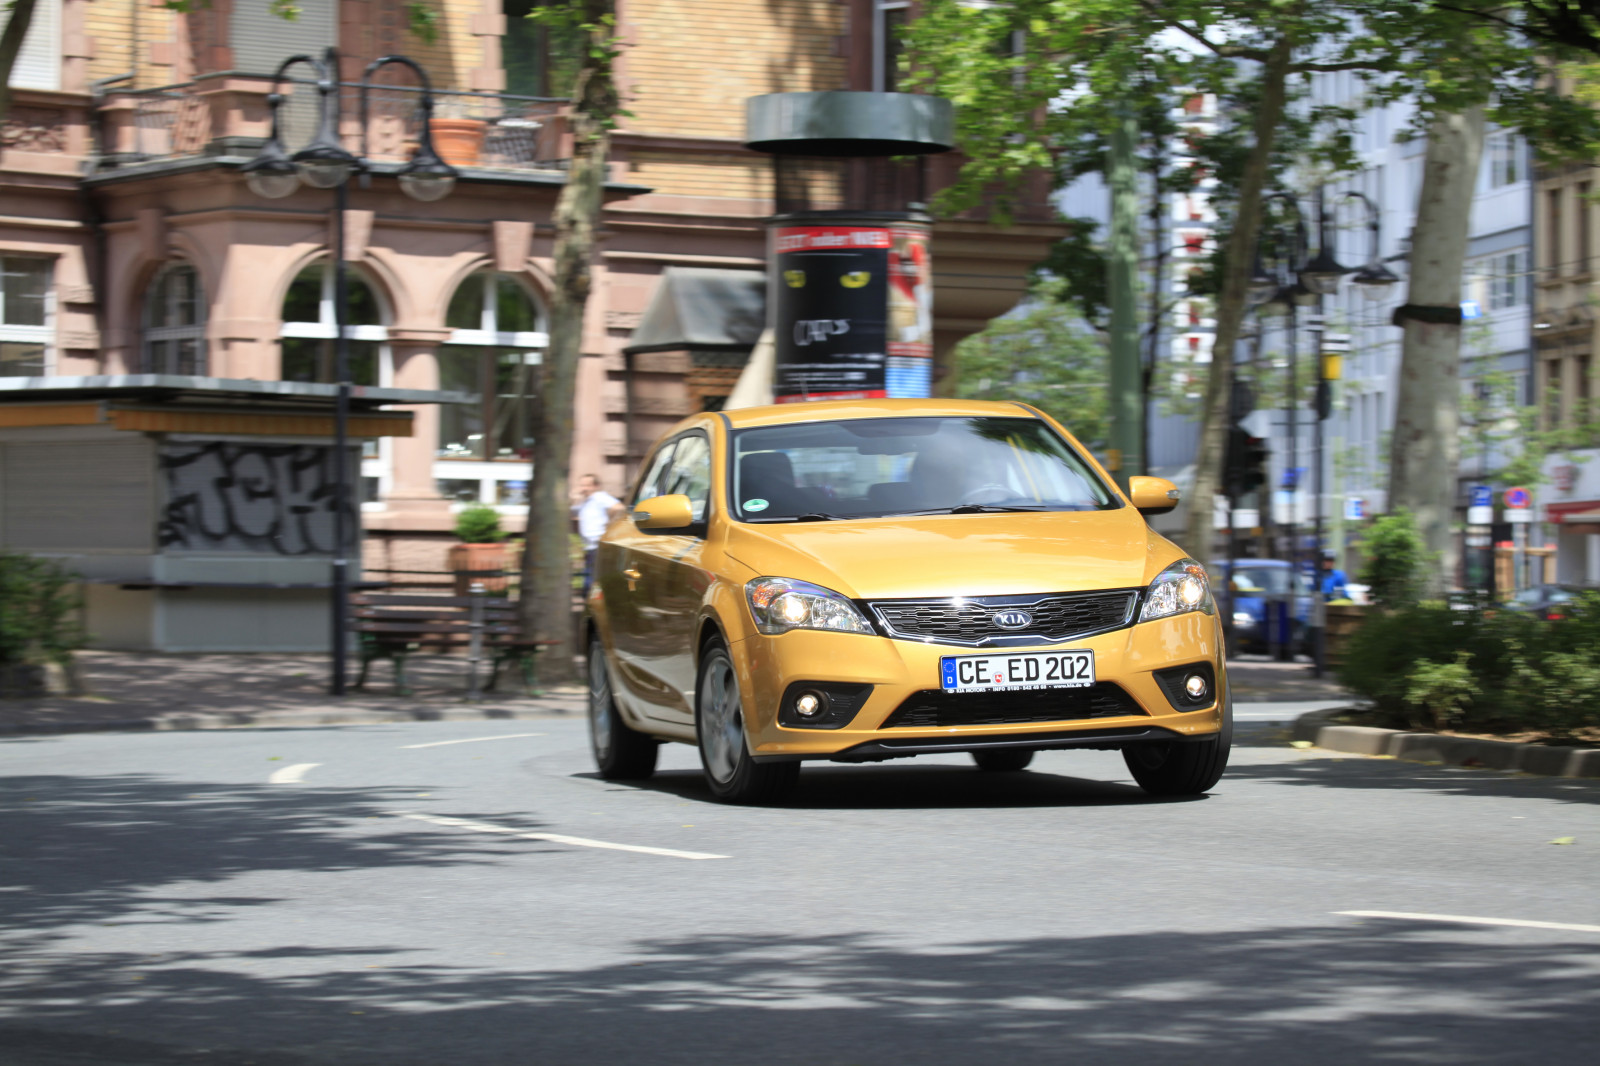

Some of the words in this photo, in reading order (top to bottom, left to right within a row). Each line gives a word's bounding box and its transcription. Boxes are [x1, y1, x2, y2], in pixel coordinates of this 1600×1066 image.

[1000, 614, 1026, 624] KIA
[959, 660, 991, 684] CE
[1008, 658, 1040, 682] ED
[1046, 656, 1090, 680] 202
